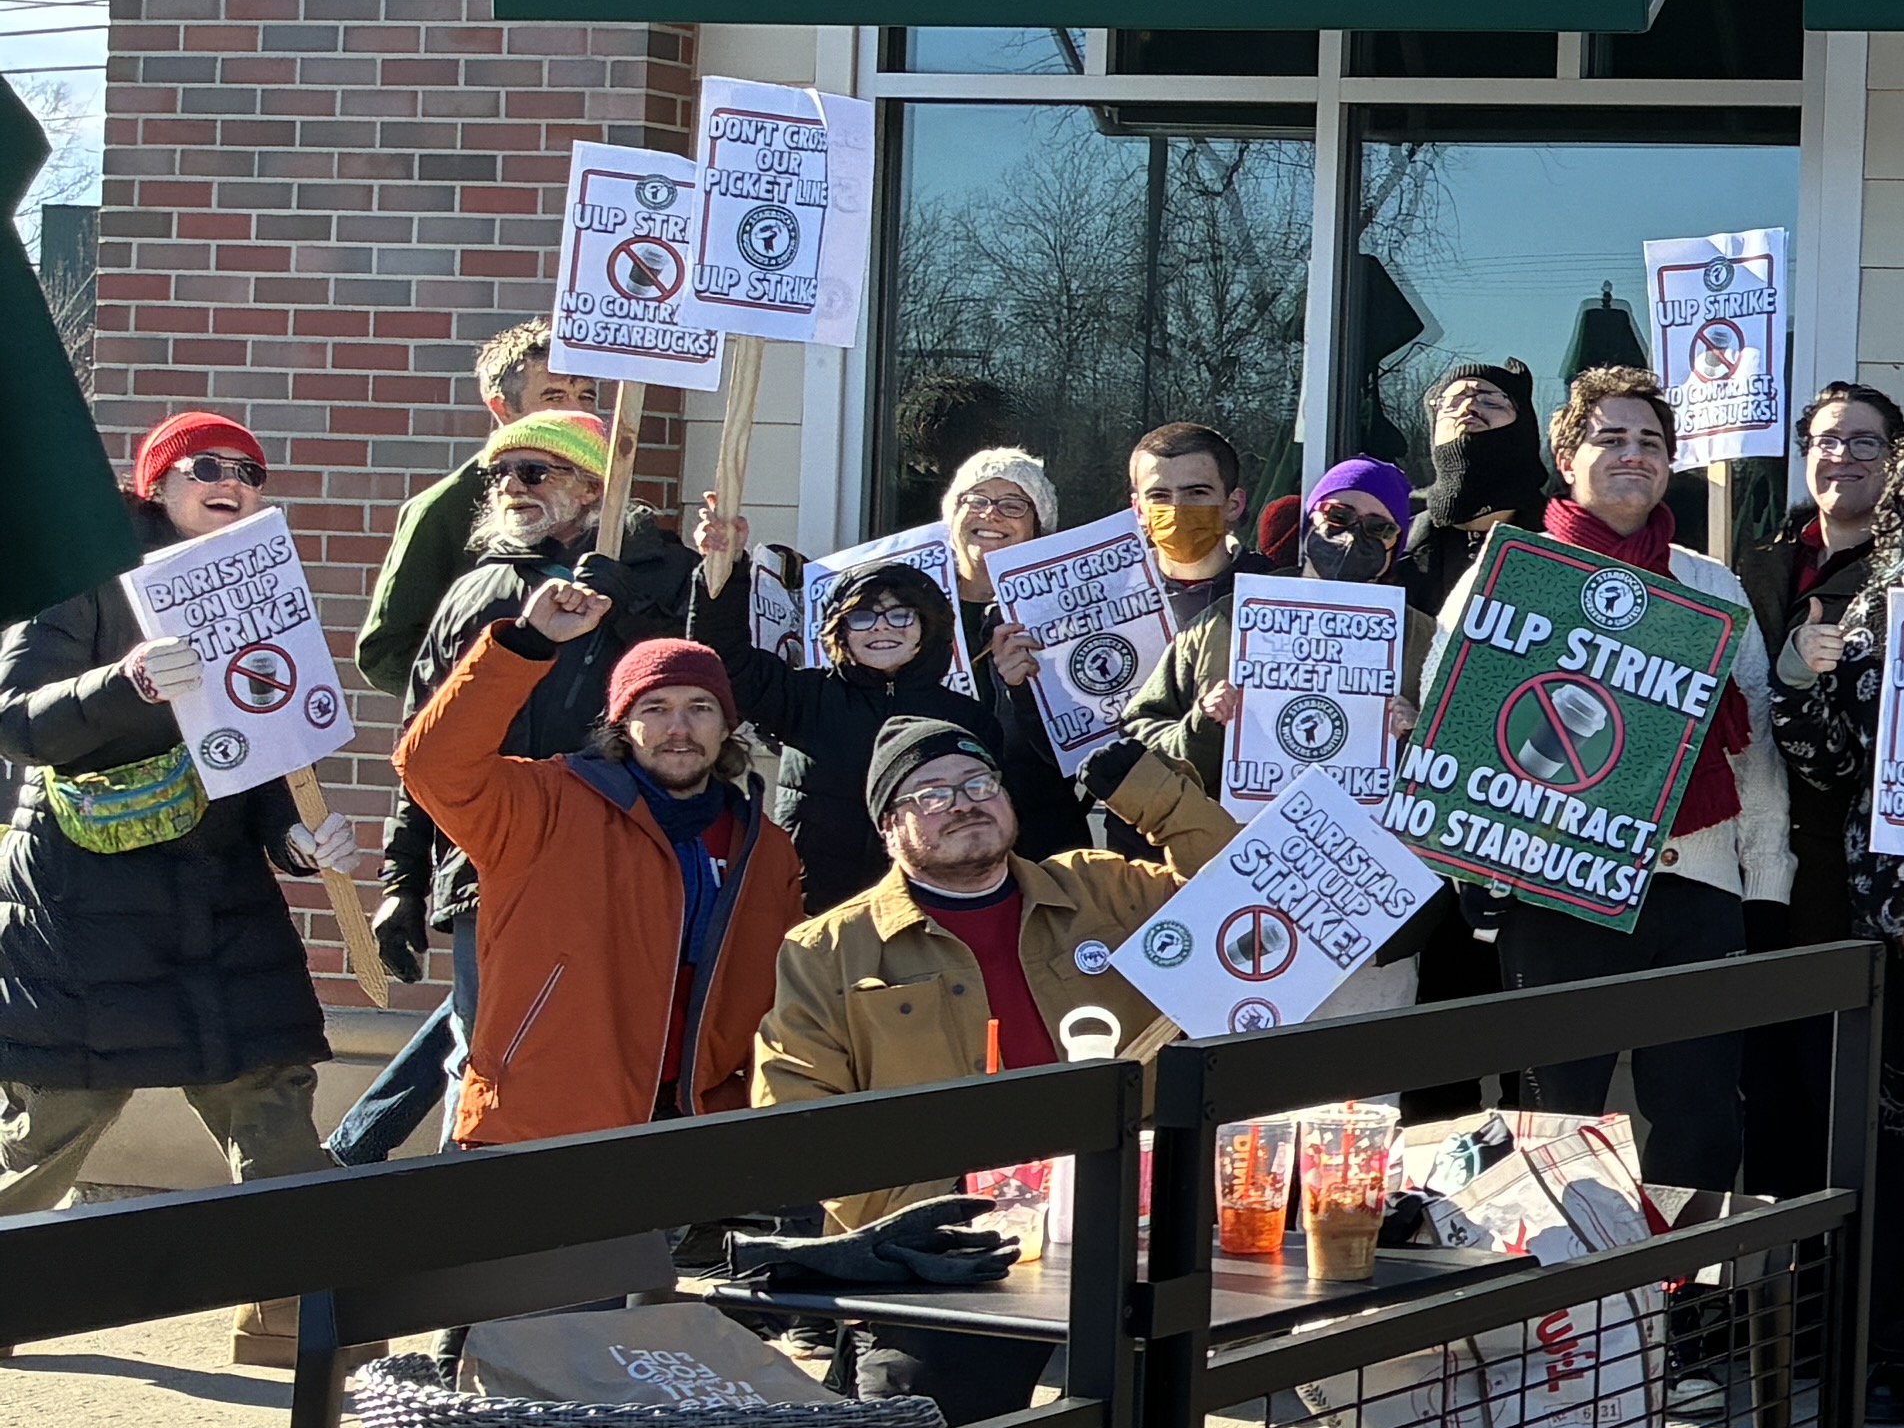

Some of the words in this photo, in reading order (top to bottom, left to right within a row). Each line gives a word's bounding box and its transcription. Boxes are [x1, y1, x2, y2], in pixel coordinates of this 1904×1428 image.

[709, 114, 778, 148] DON'T
[756, 148, 802, 174] OUR
[705, 167, 792, 204] PICKET
[573, 203, 626, 234] ULP
[634, 212, 690, 244] STR
[693, 264, 741, 297] ULP
[561, 291, 594, 314] NO
[601, 295, 681, 323] CONTR
[1656, 299, 1699, 327] ULP
[1704, 287, 1777, 321] STRIKE
[557, 317, 587, 341] NO
[594, 322, 717, 358] STARBUCKS!
[1687, 374, 1778, 404] CONTRACT,
[1684, 400, 1778, 432] STARBUCKS!
[147, 535, 292, 613] BARISTAS
[897, 545, 948, 572] OSS
[998, 566, 1070, 604] DON'T
[1072, 542, 1147, 581] CROSS
[184, 594, 226, 627] ON
[229, 573, 278, 610] ULP
[753, 594, 787, 625] ULP
[1058, 582, 1107, 613] OUR
[188, 586, 312, 662] TRIKE!
[1026, 609, 1104, 650] ICKET
[1110, 590, 1165, 625] LINE
[1238, 606, 1314, 634] DON'T
[1319, 614, 1397, 641] CROSS
[1292, 636, 1341, 663] OUR
[1463, 593, 1552, 656] ULP
[1557, 628, 1718, 721] STRIKE
[1234, 661, 1331, 694] PICKET
[1338, 665, 1395, 697] LINE
[1047, 706, 1097, 745] ULP
[1227, 759, 1283, 792] ULP
[1291, 764, 1391, 798] RIKE
[1402, 745, 1458, 790] NO
[1466, 767, 1658, 866] CONTRACT,
[1281, 791, 1416, 919] BARISTAS
[1383, 792, 1436, 838] NO
[1439, 809, 1650, 907] STARBUCKS!
[1281, 835, 1321, 879] ON
[1317, 868, 1372, 917] ULP
[1230, 839, 1372, 971] STRIKE!
